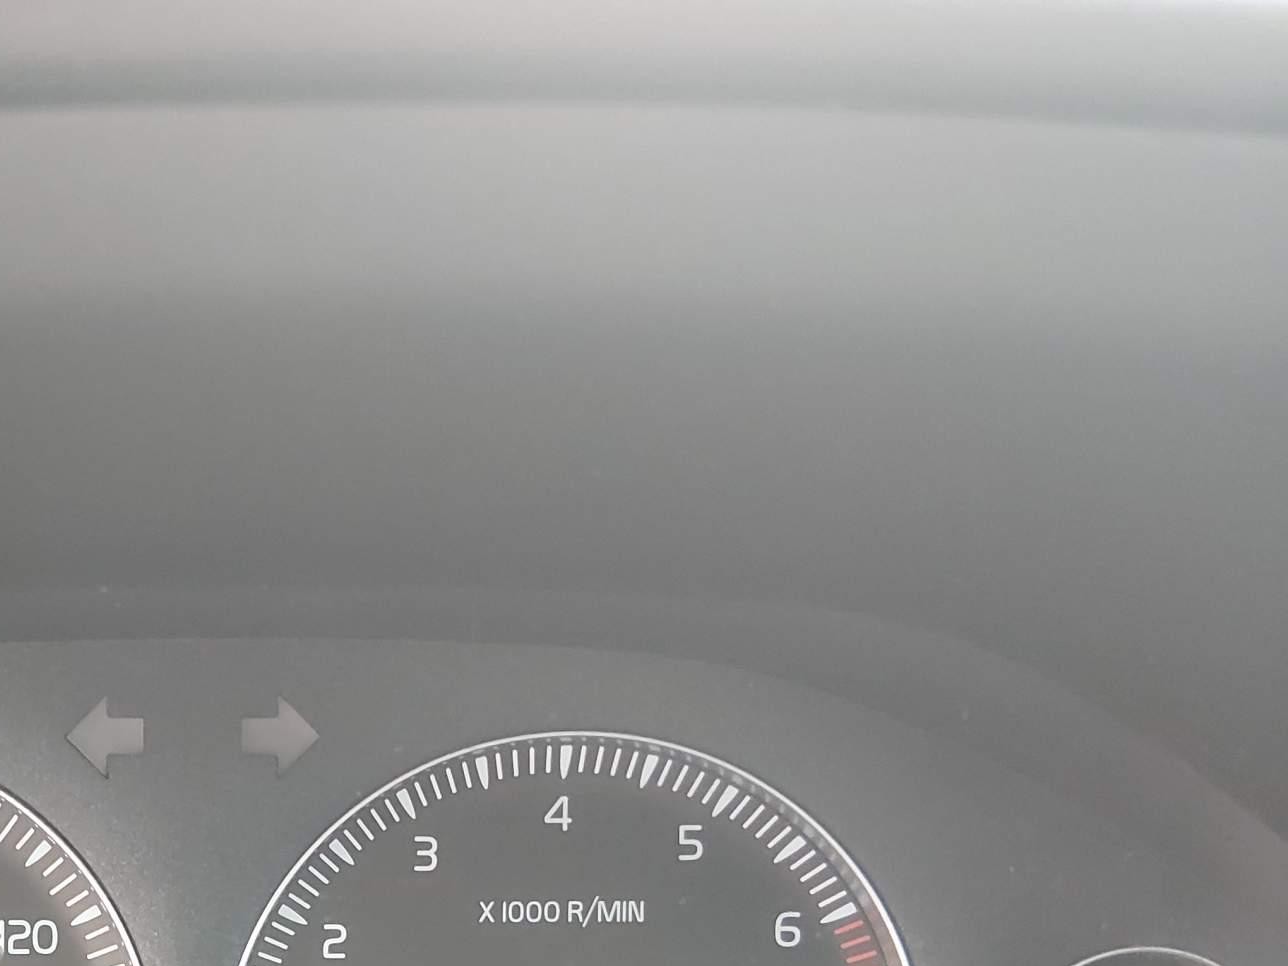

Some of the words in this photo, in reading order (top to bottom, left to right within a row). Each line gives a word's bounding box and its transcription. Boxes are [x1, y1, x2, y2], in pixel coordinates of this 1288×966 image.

[544, 796, 572, 832] 4
[413, 836, 438, 871] 3
[678, 825, 703, 861] 5
[478, 900, 495, 922] X
[501, 900, 561, 923] 1000
[567, 896, 645, 928] R/MIN
[774, 911, 801, 947] 6
[322, 923, 347, 959] 2
